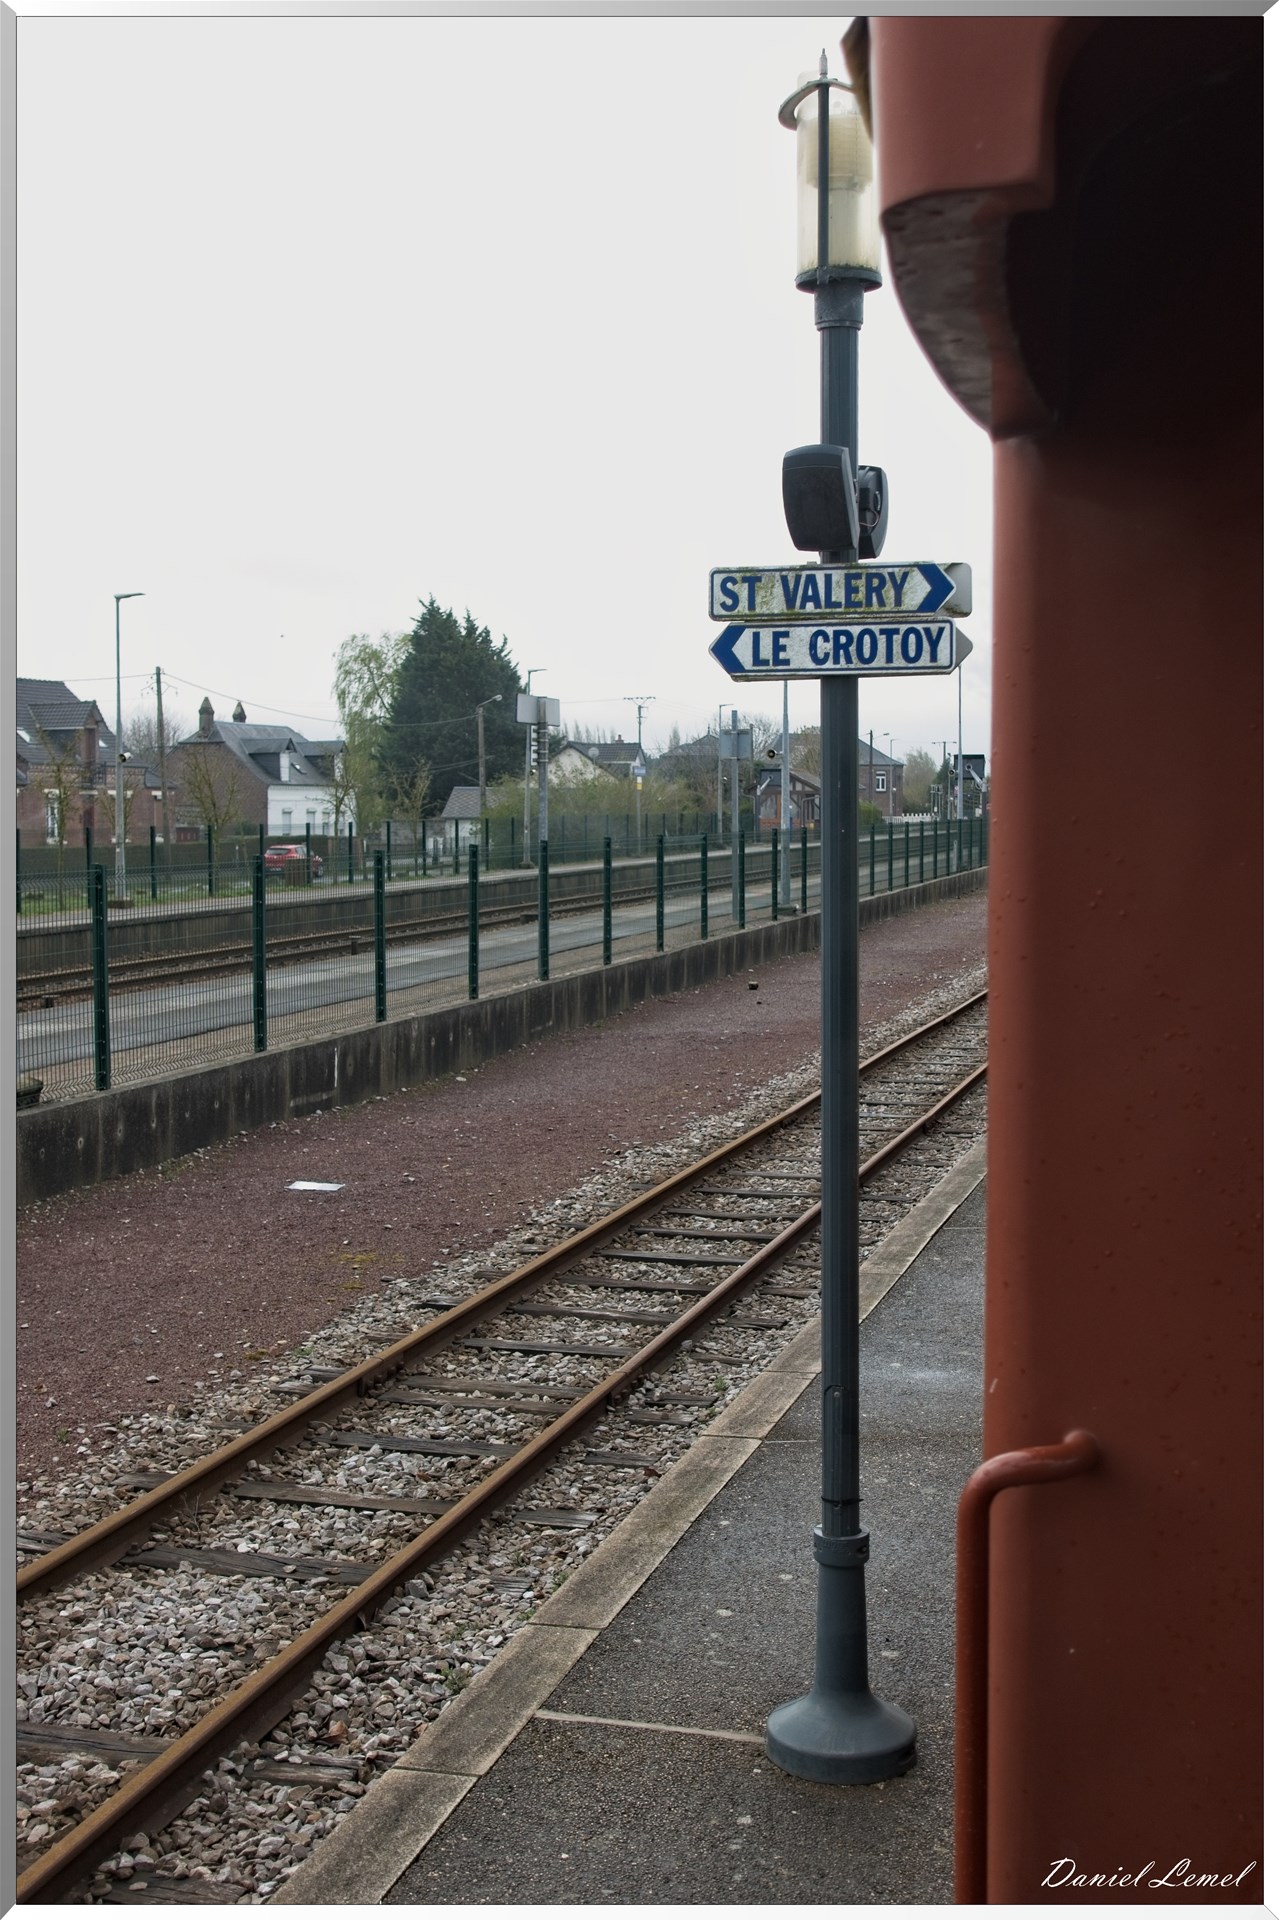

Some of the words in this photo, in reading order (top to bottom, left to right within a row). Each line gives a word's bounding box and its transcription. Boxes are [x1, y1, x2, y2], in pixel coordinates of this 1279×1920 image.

[719, 576, 761, 612] ST
[780, 571, 909, 609] VALERY
[752, 630, 790, 666] LE
[808, 626, 945, 665] CROTOY
